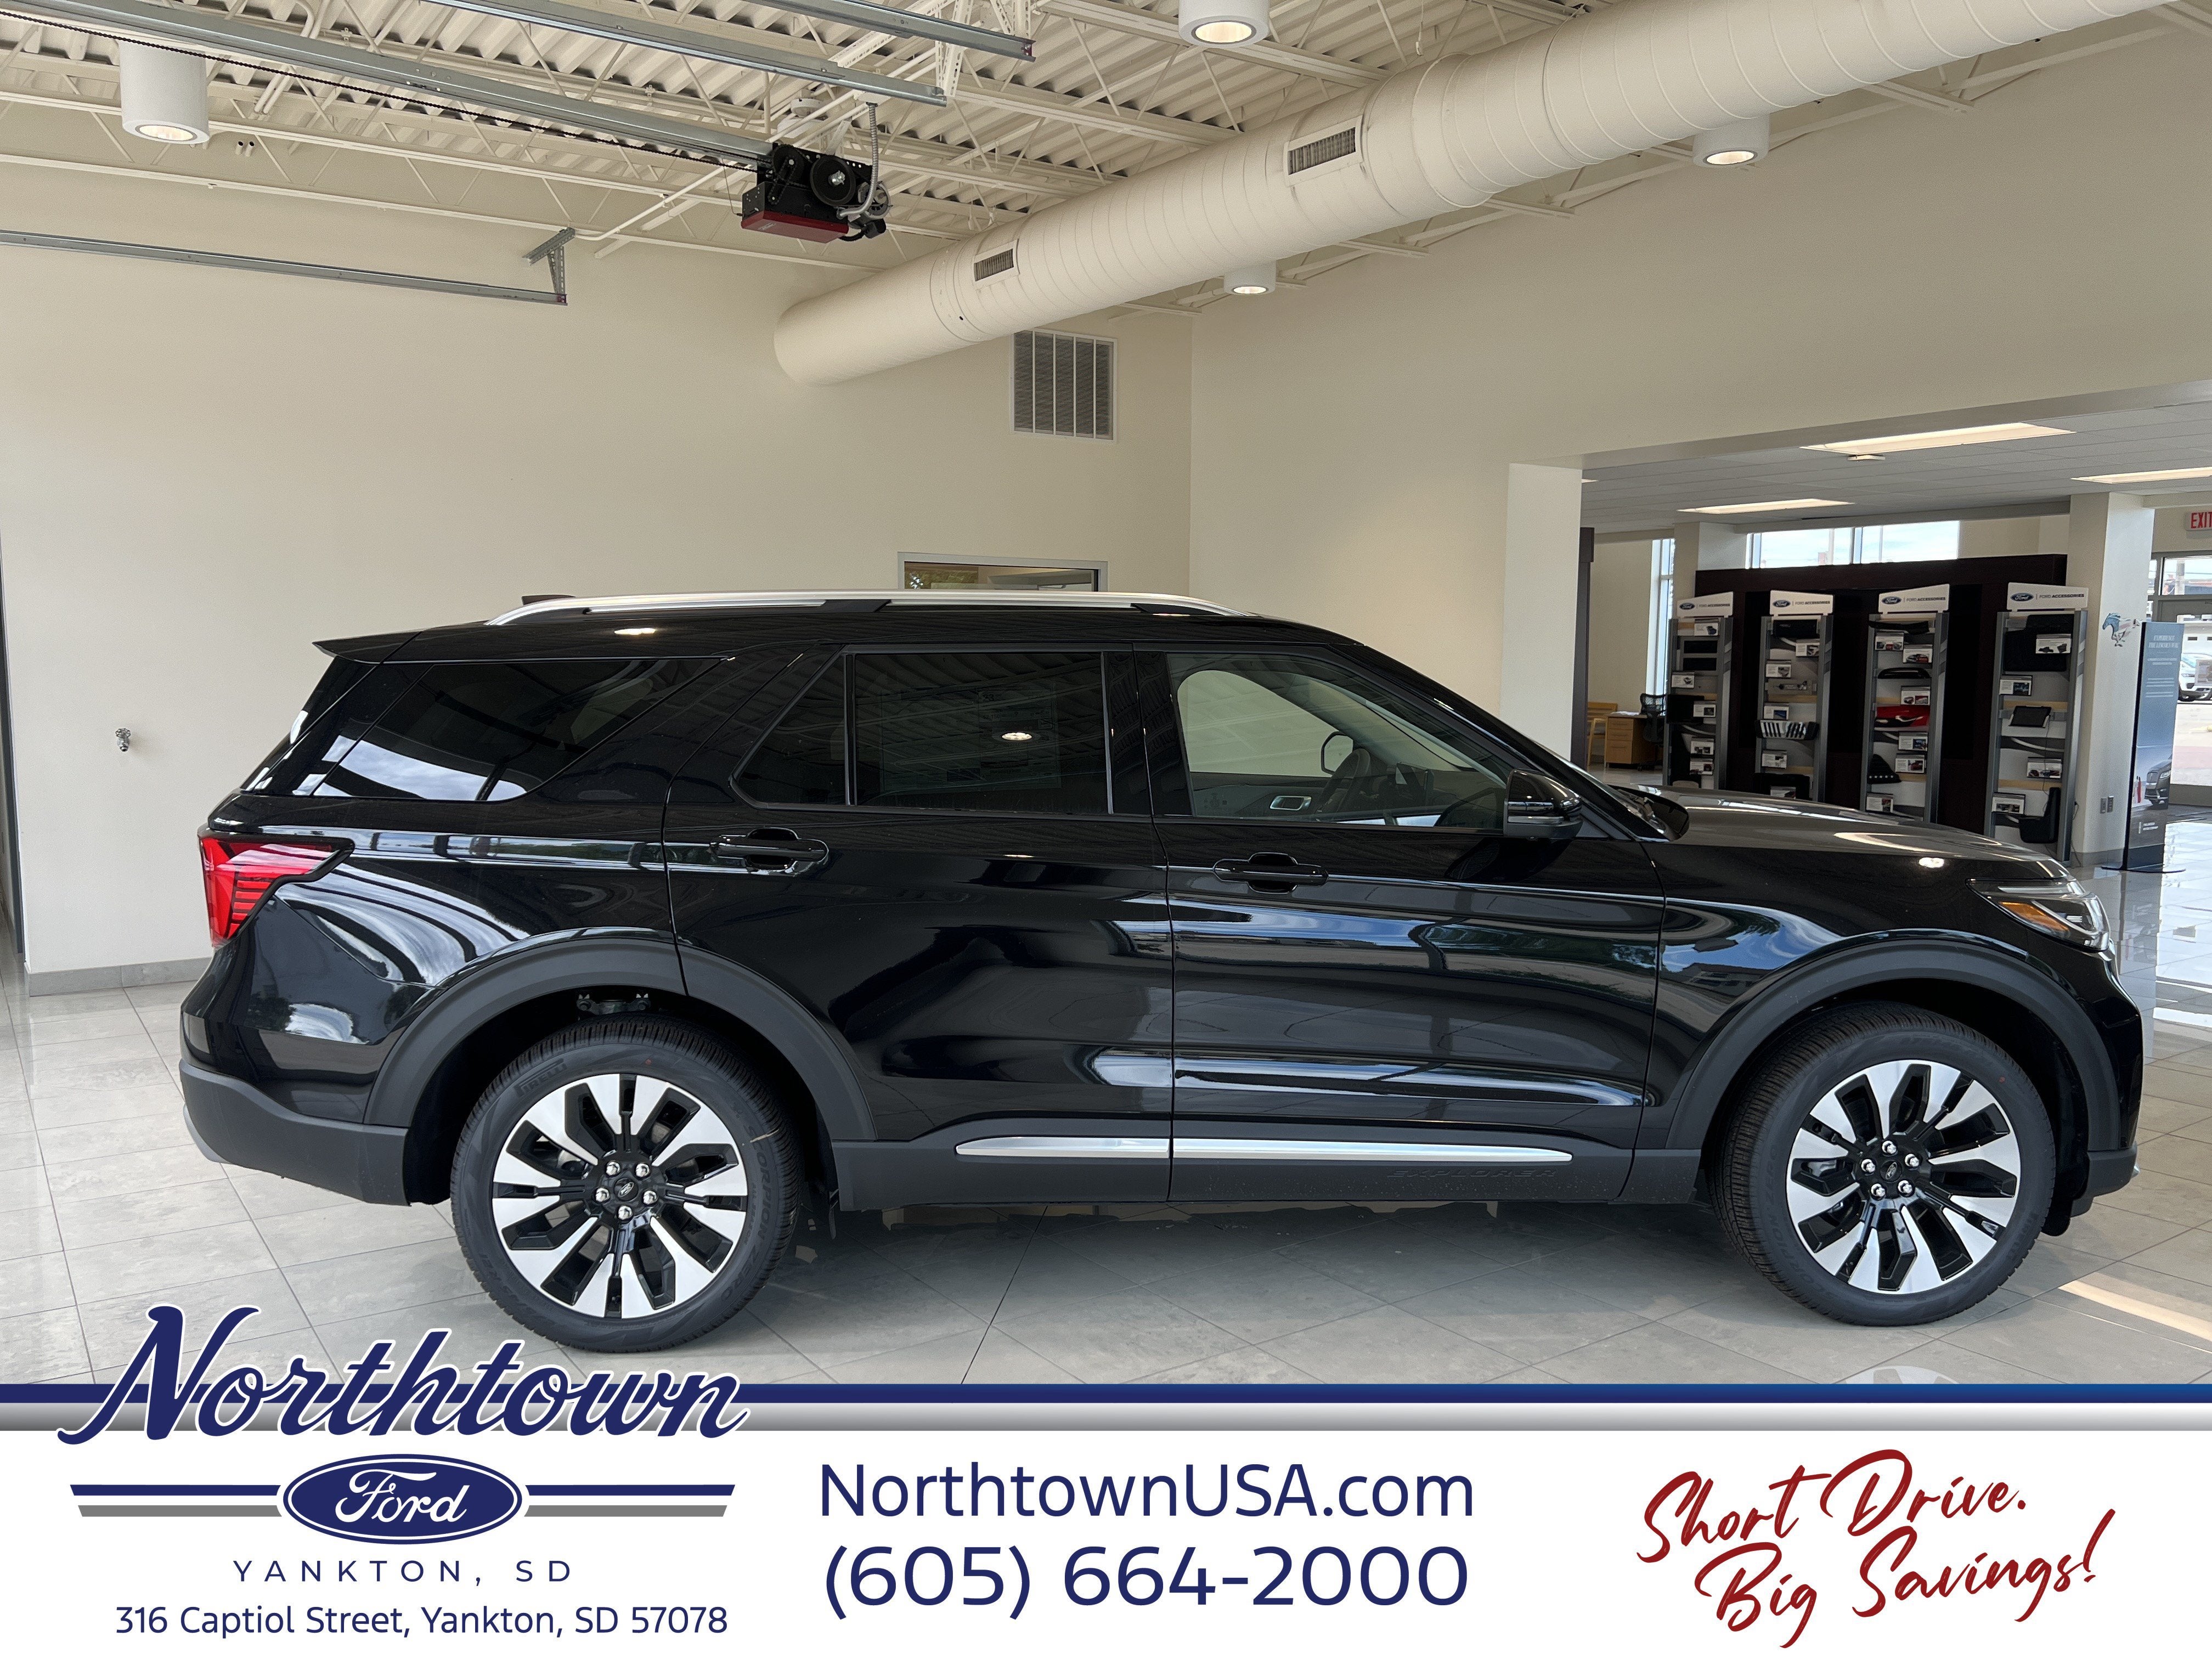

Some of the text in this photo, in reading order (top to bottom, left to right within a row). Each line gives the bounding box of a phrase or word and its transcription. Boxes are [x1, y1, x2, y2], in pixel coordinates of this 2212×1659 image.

[2191, 511, 2212, 528] EXIT
[515, 1058, 568, 1098] PIRELLI
[1386, 1169, 1558, 1178] EXPLORER
[718, 1124, 772, 1303] SCORPION ZERO
